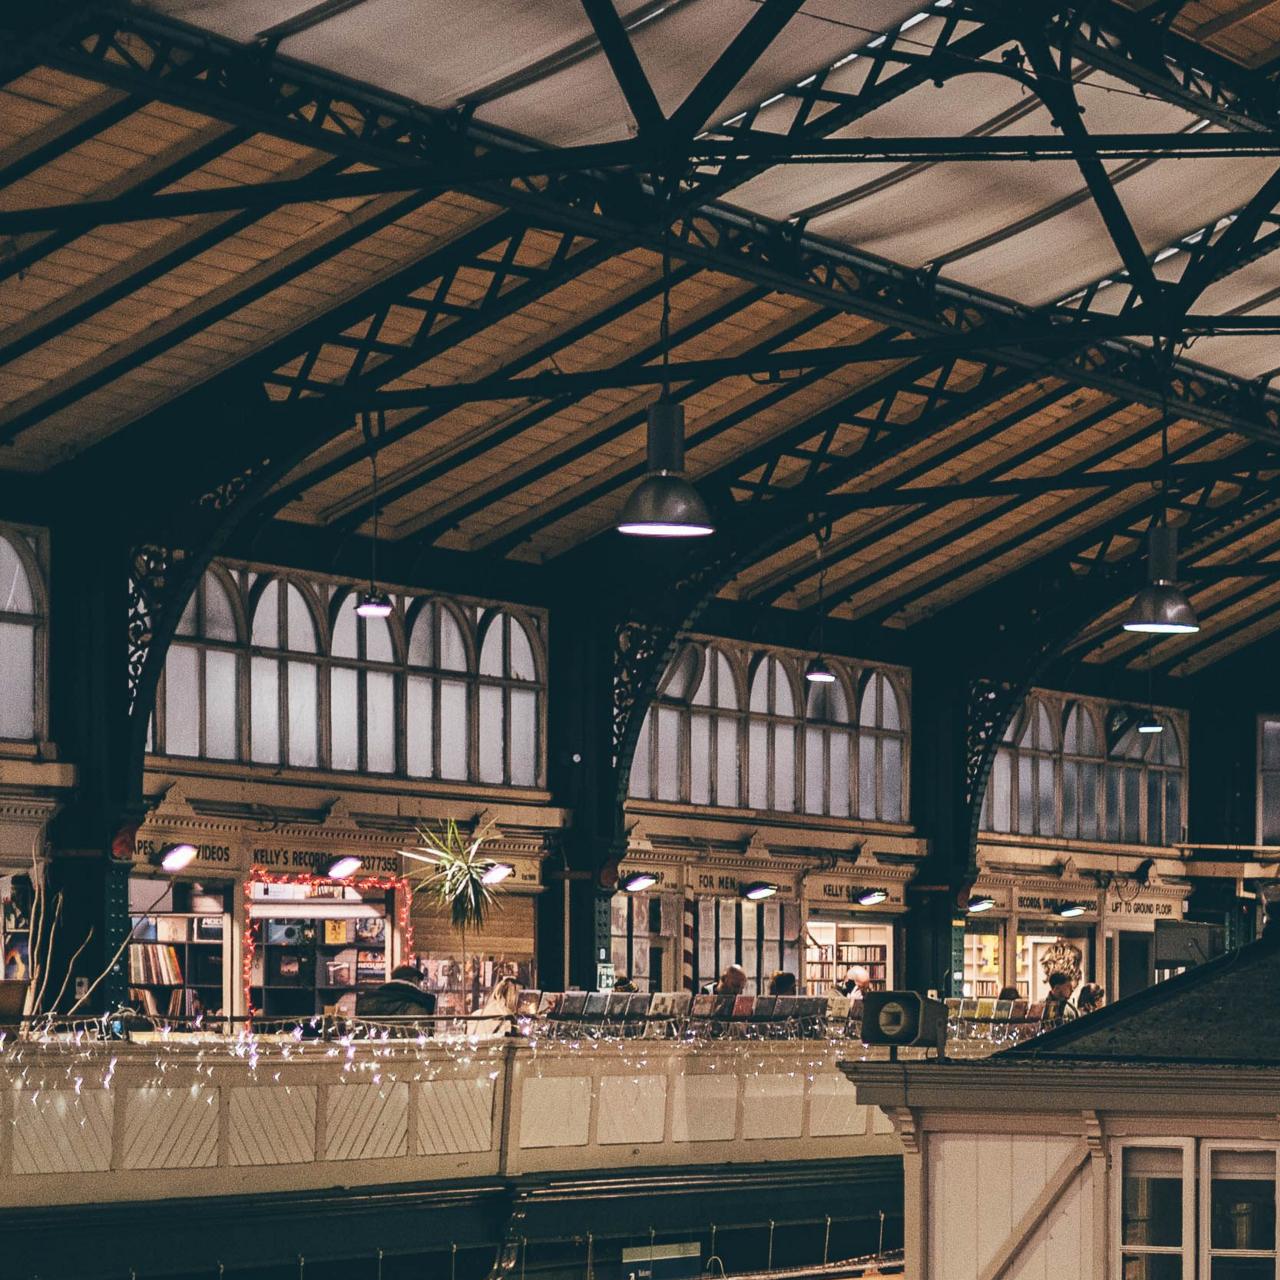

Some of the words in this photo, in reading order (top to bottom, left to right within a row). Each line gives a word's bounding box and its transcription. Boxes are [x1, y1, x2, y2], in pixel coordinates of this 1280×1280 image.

[699, 875, 714, 888] FOR
[1112, 901, 1122, 913] LIFT
[1124, 902, 1132, 914] TO
[1133, 902, 1154, 915] GROUND
[1156, 903, 1172, 915] FLOOR
